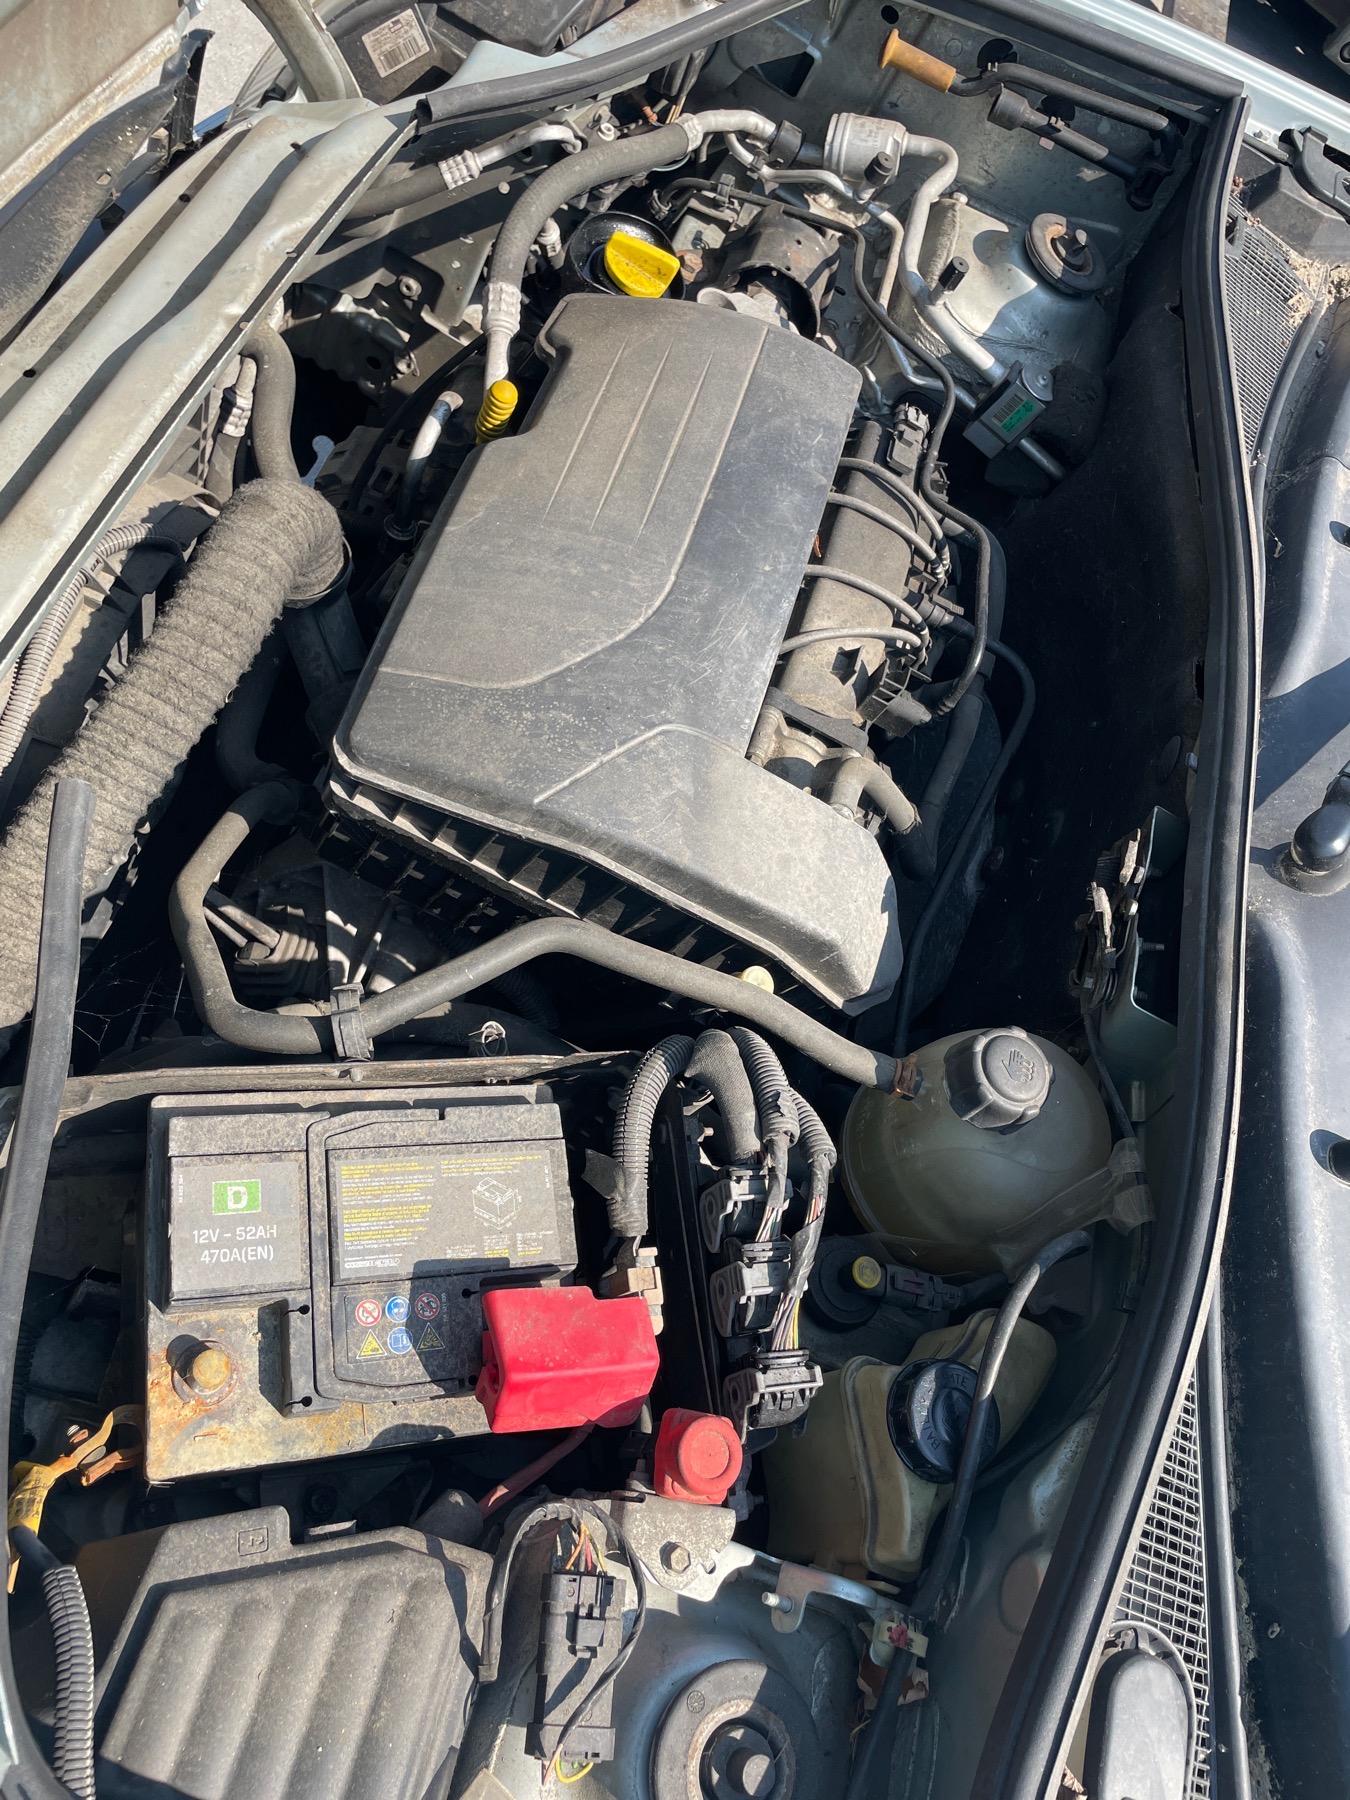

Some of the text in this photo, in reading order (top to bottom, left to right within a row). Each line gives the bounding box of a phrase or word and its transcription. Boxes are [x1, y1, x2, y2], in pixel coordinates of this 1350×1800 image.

[227, 1186, 248, 1209] D
[192, 1229, 220, 1244] 12V
[236, 1225, 278, 1241] 52AH
[200, 1245, 274, 1264] 470A(EN)
